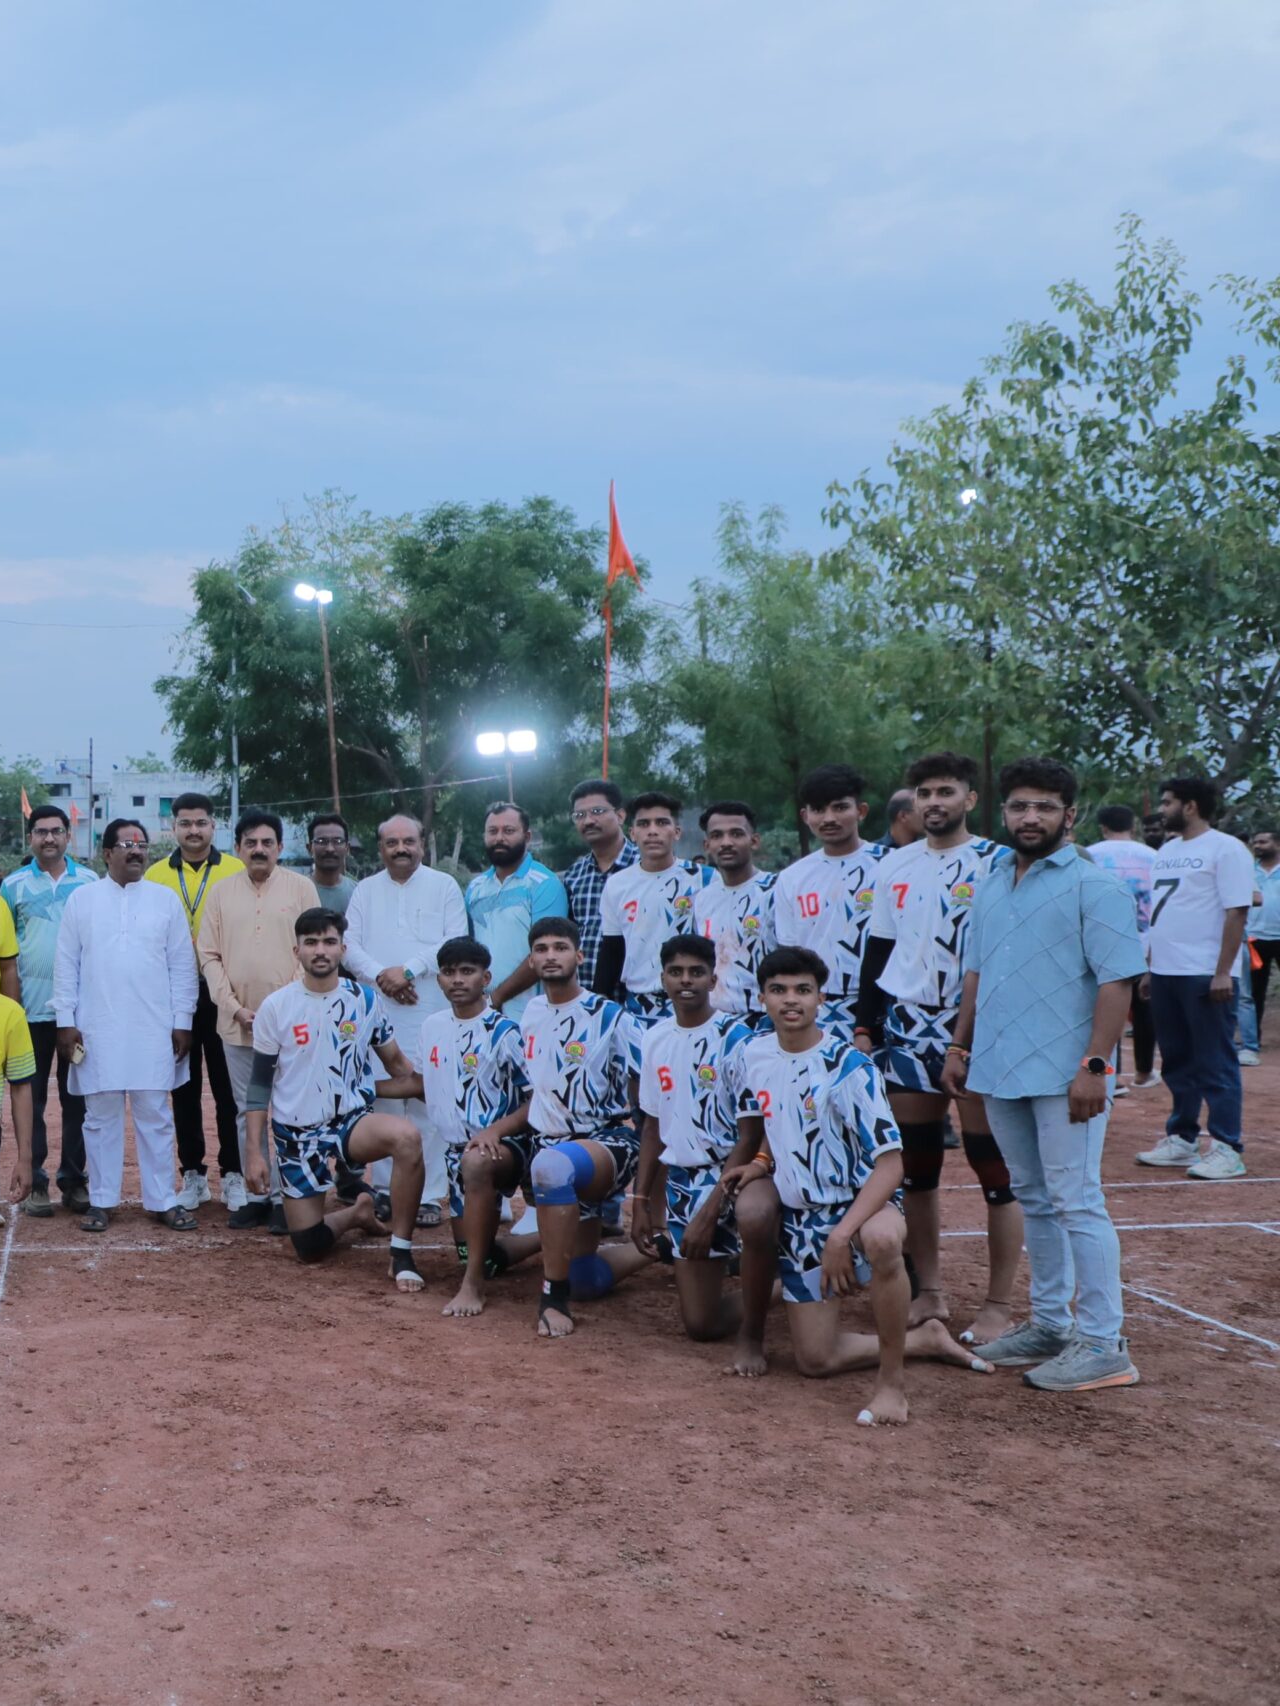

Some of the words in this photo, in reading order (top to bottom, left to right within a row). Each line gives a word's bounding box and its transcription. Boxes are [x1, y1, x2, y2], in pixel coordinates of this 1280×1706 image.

[1152, 857, 1203, 871] ONALDO
[797, 892, 820, 919] 10
[892, 883, 909, 909] 7
[1150, 878, 1180, 927] 7
[293, 1024, 309, 1046] 5
[430, 1045, 439, 1068] 4
[757, 1090, 772, 1118] 2
